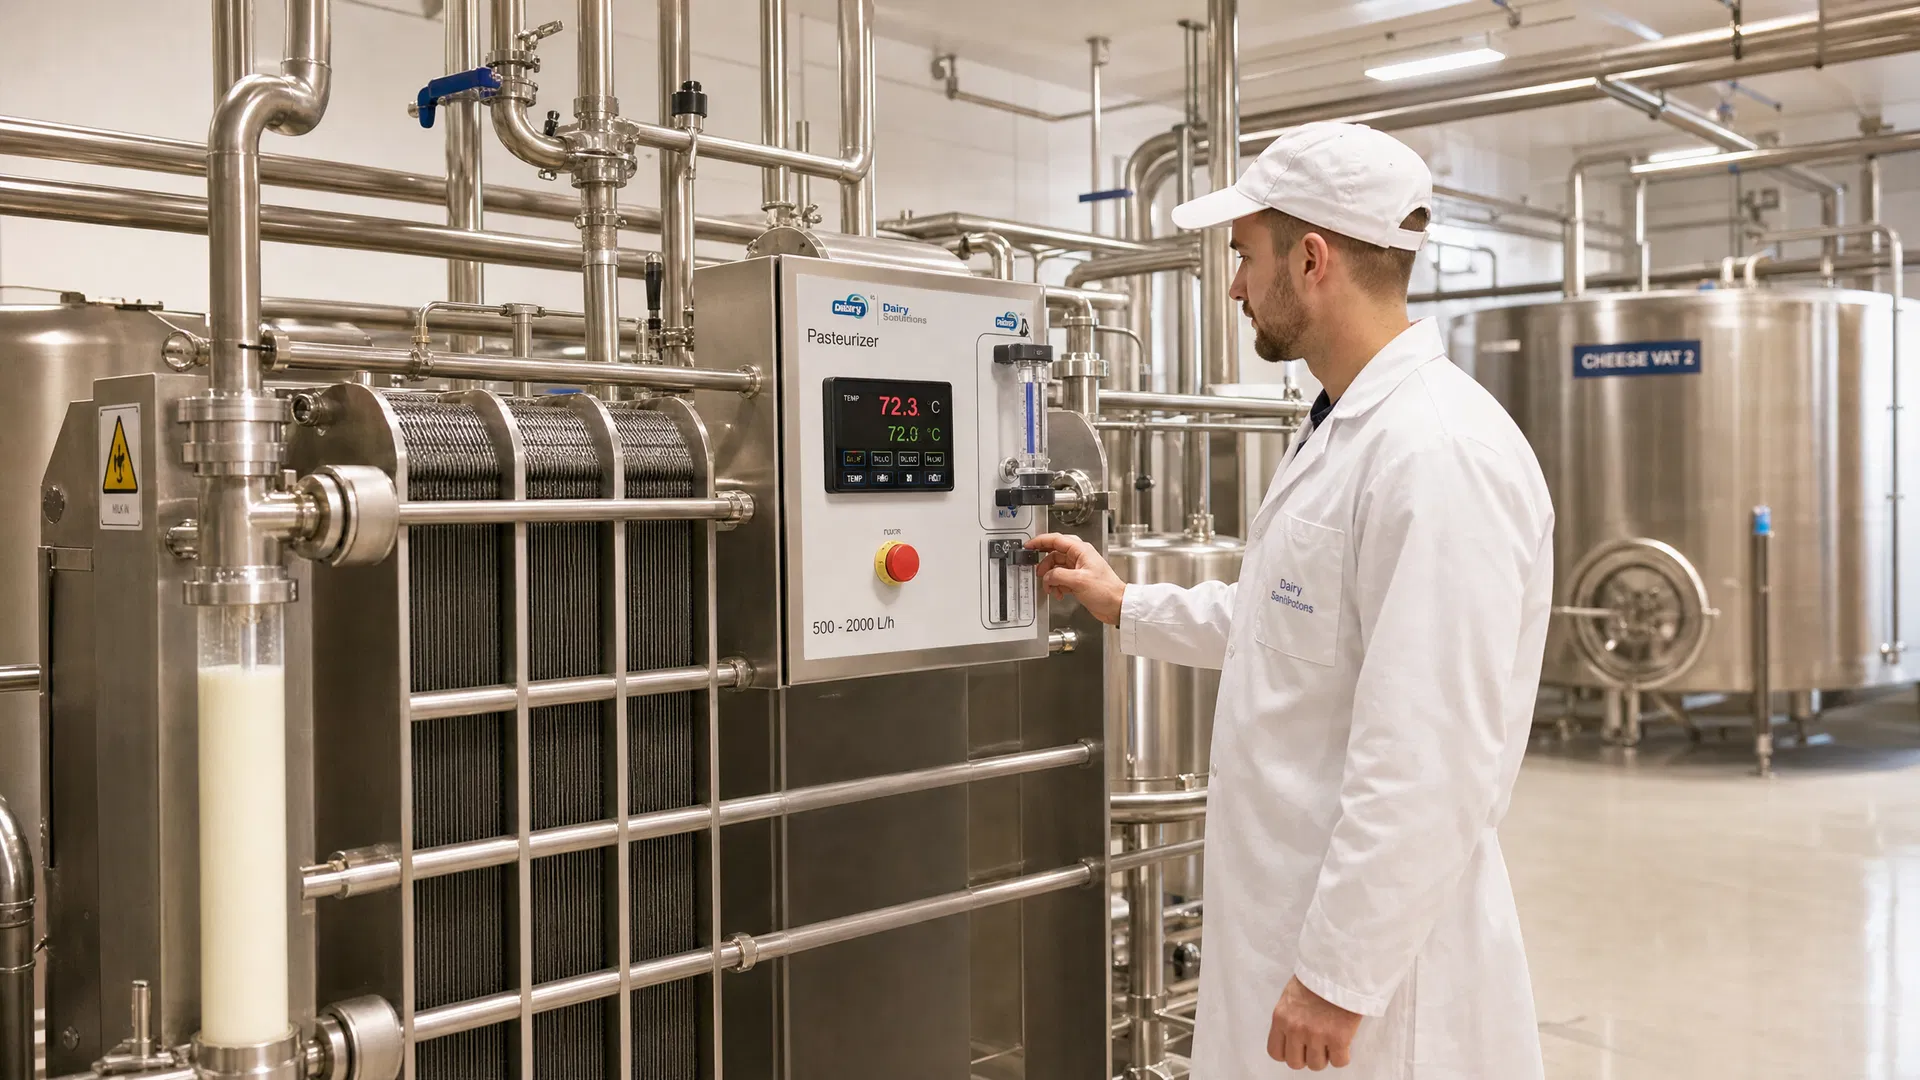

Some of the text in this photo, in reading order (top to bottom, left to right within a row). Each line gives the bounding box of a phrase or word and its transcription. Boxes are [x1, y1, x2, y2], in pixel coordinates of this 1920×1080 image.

[883, 303, 909, 316] Dairy
[807, 328, 879, 348] Pasteurizer
[1581, 349, 1695, 369] CHEESE VAT 2
[843, 394, 860, 402] TEMP
[888, 425, 941, 442] 72.0 °C
[847, 474, 863, 483] TEMP
[1280, 578, 1303, 597] Dairy
[813, 620, 835, 635] 500
[846, 617, 875, 632] 2000
[877, 616, 895, 630] L/h
